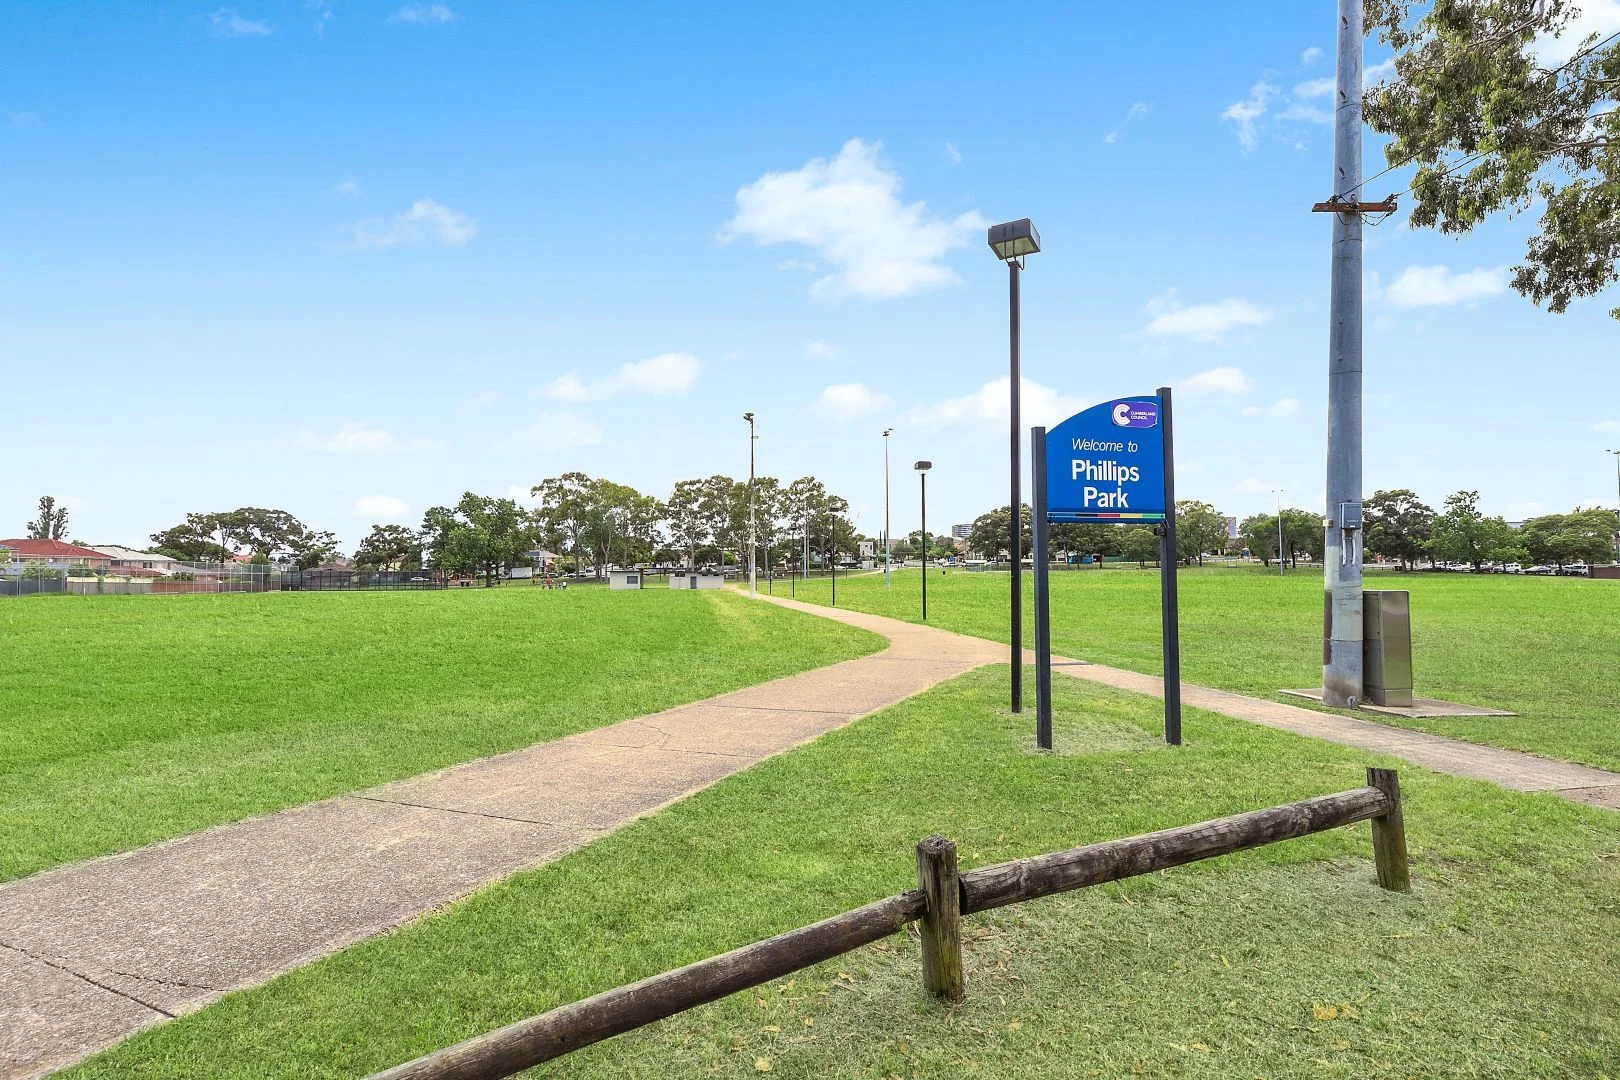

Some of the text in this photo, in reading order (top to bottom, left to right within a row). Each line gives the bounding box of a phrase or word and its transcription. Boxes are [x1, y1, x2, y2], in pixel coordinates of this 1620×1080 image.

[1072, 438, 1138, 452] Welcome to
[1071, 459, 1140, 486] Phillips
[1083, 486, 1129, 508] Park
